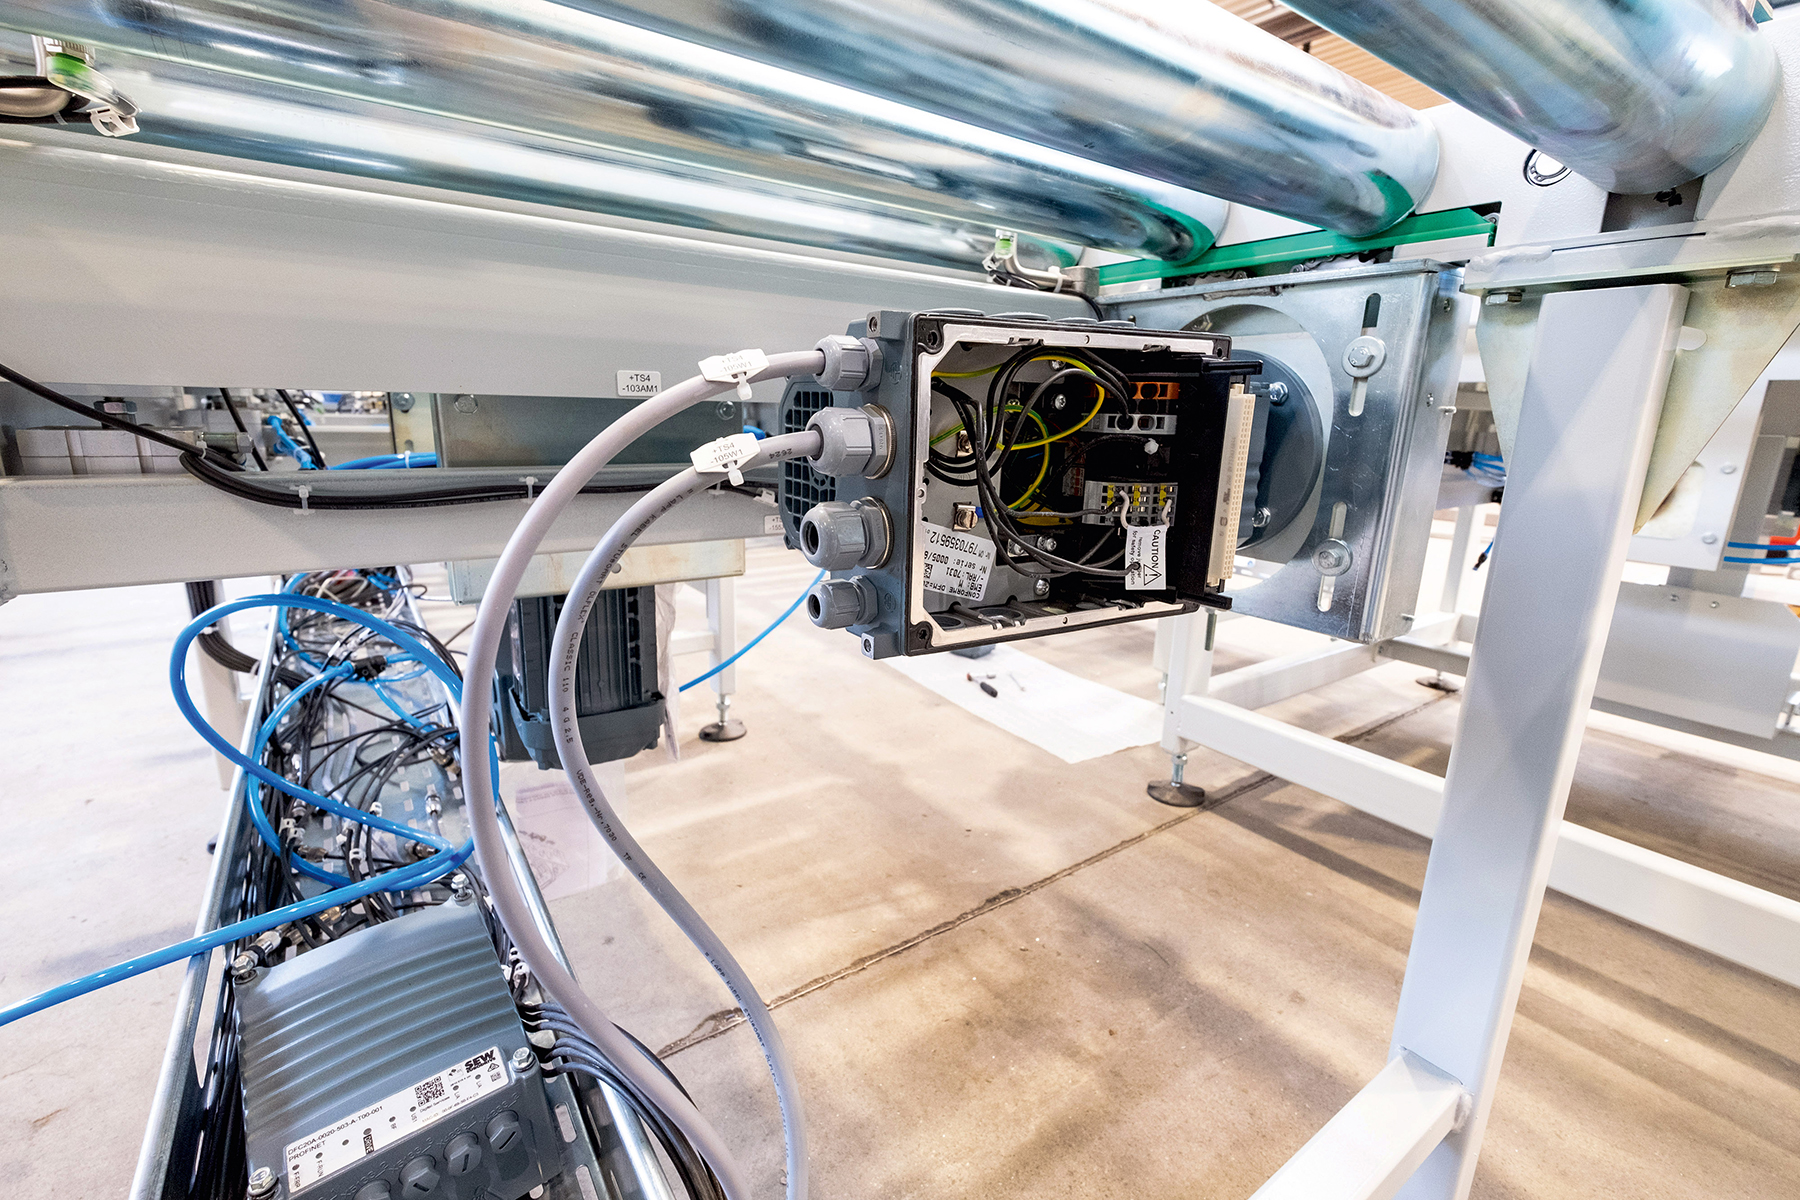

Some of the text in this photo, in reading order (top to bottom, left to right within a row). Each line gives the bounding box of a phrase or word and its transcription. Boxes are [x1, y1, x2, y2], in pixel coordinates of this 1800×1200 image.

[629, 374, 651, 382] +TS4
[622, 385, 658, 393] -103AM1
[712, 442, 735, 453] +TS4
[710, 449, 743, 464] -105W1
[630, 514, 657, 537] KABEL
[930, 531, 979, 556] 7970359512
[1151, 529, 1161, 569] CAUTION
[979, 565, 987, 574] Nr
[949, 586, 980, 599] CONFORME
[958, 580, 983, 592] EMB: M
[563, 631, 579, 672] CLASSIC
[464, 1049, 495, 1069] SEW
[288, 1140, 327, 1162] PROFINET
